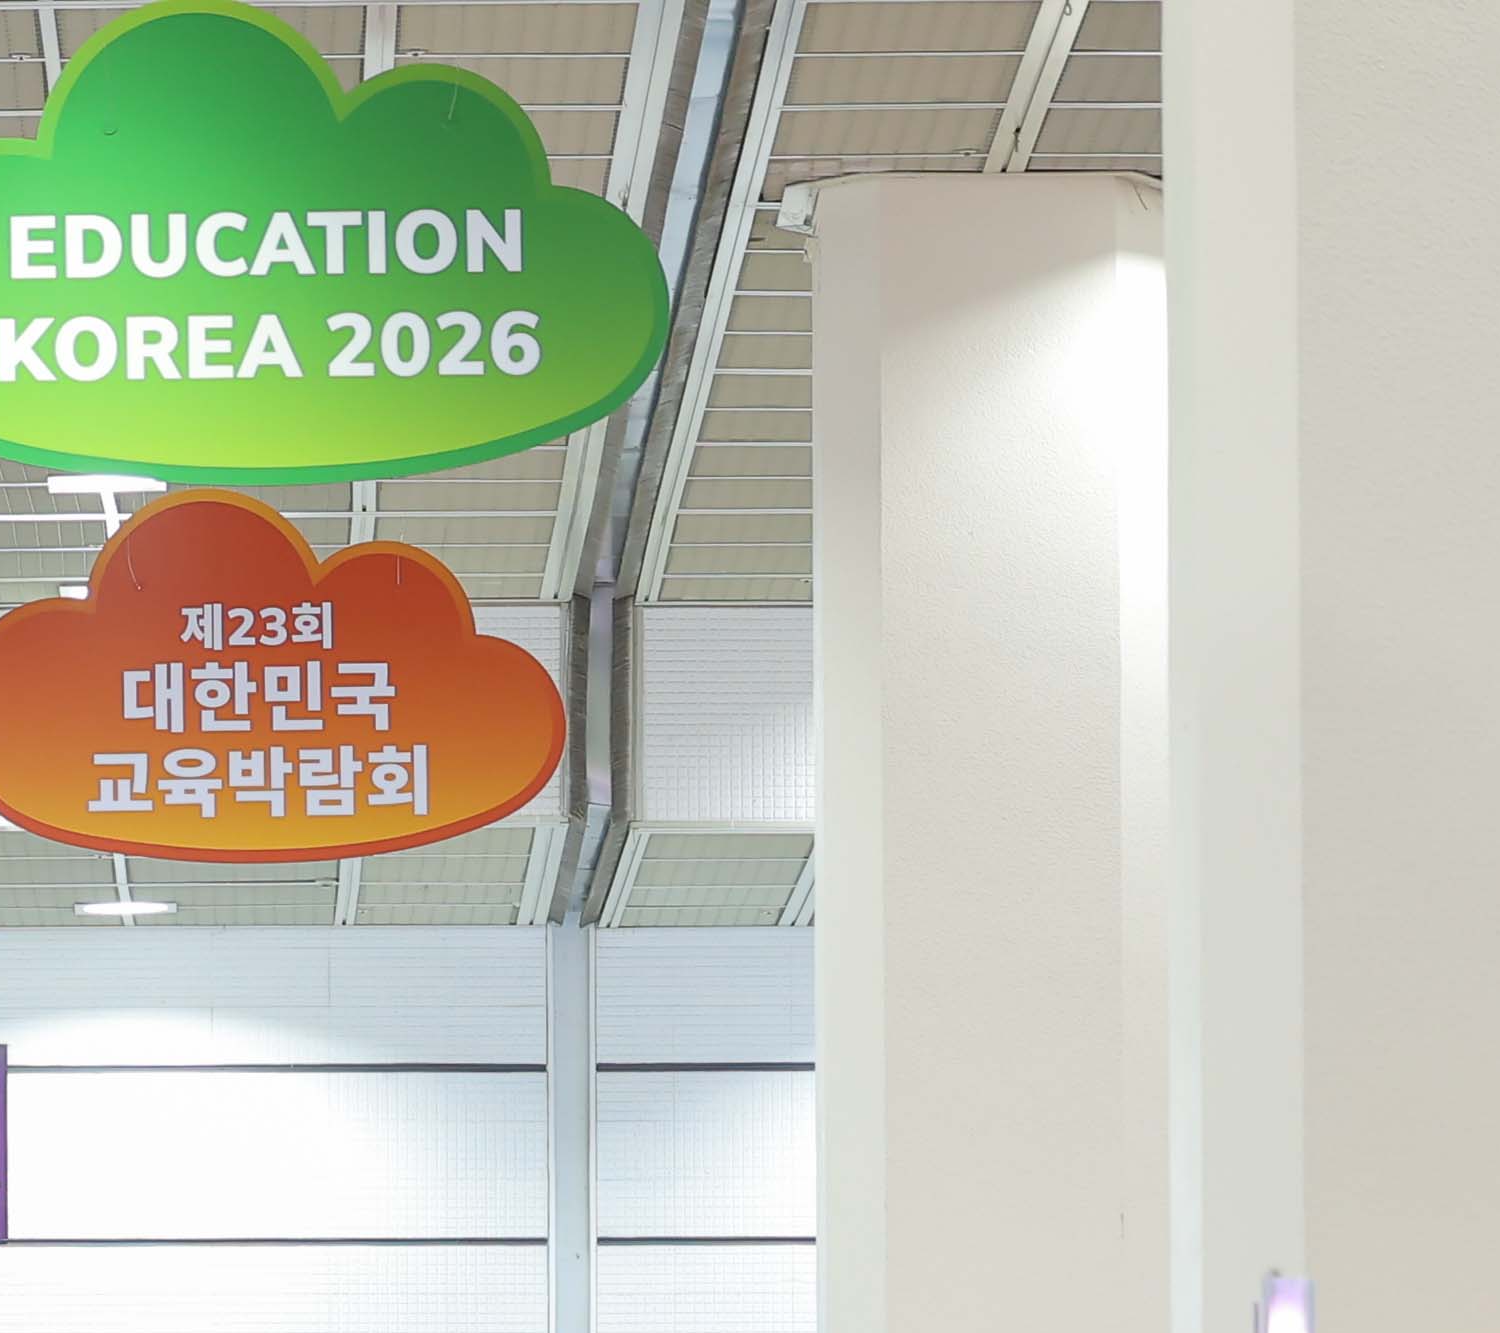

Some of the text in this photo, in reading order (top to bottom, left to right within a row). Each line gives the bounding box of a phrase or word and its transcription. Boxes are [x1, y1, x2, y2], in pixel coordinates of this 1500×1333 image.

[8, 208, 524, 281] EDUCATION
[326, 310, 542, 378] 2026
[179, 602, 335, 651] 제23회
[122, 660, 397, 734] 대한민국
[87, 744, 430, 818] 교육박람회
